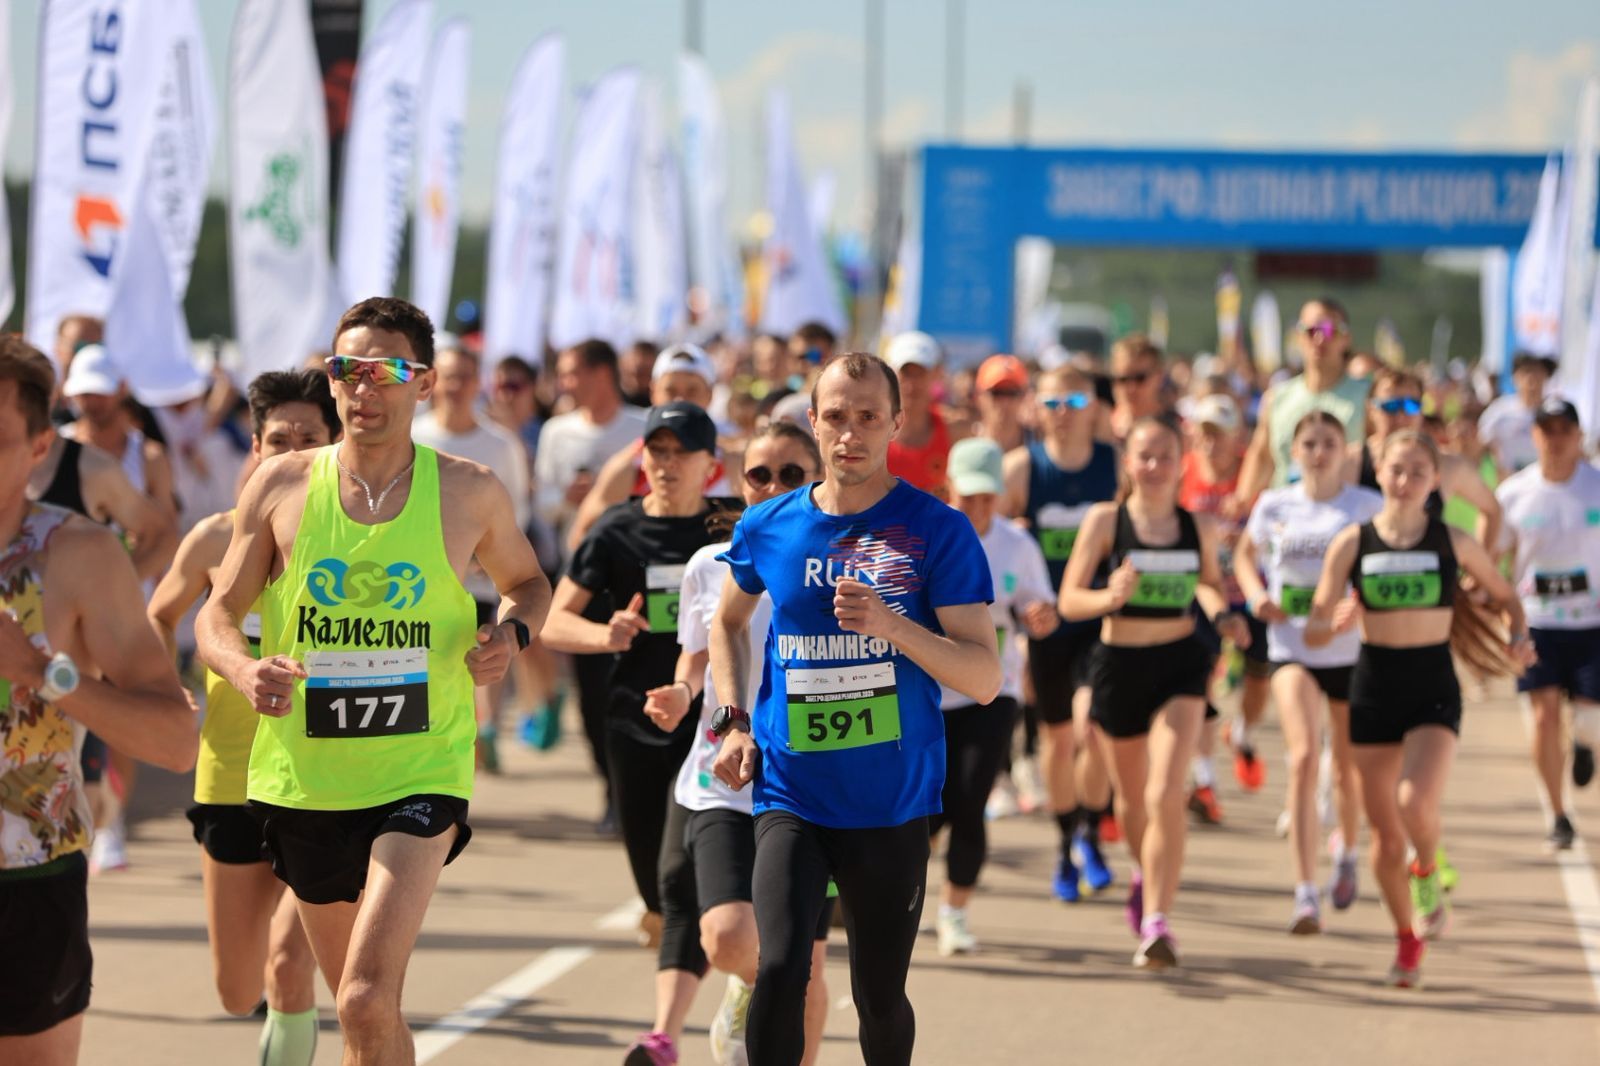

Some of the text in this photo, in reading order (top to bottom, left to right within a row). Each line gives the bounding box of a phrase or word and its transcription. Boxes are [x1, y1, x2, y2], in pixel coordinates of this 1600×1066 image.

[81, 11, 120, 170] ПСБ
[297, 605, 431, 649] Камелот
[328, 694, 406, 729] 177
[807, 707, 874, 743] 591
